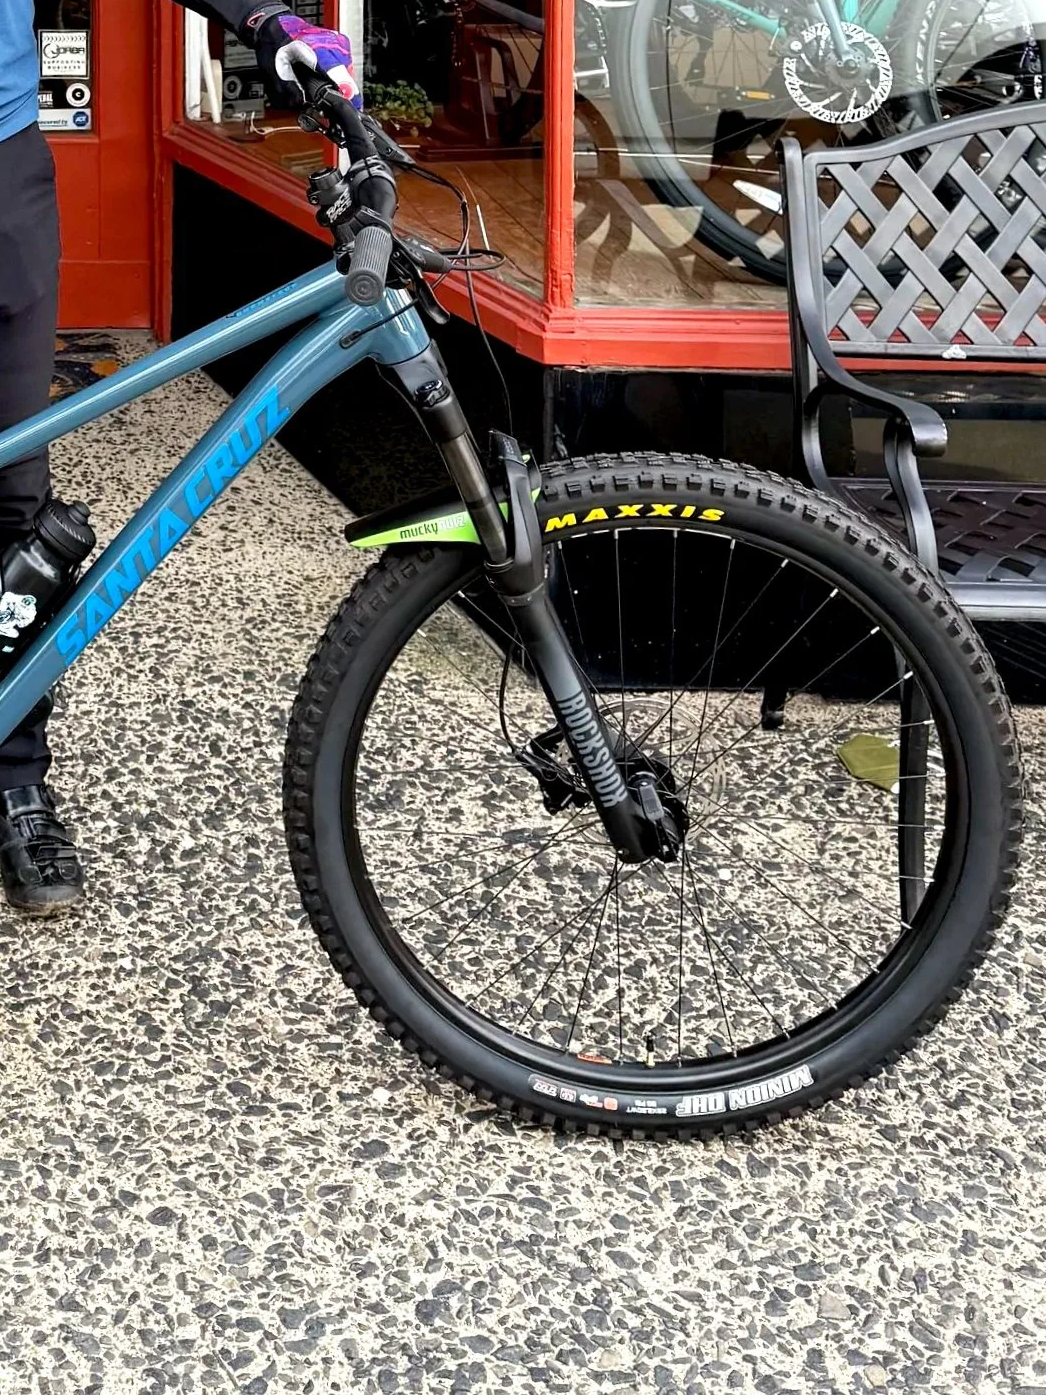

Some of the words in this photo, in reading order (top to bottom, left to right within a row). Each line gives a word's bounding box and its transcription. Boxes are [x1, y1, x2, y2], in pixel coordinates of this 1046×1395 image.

[56, 507, 189, 667] SANTA
[184, 383, 291, 518] CRUZ
[544, 503, 725, 532] MAXXIS
[557, 692, 628, 808] ROCKSHOX
[675, 1092, 726, 1118] DHF
[729, 1064, 814, 1111] MINION
